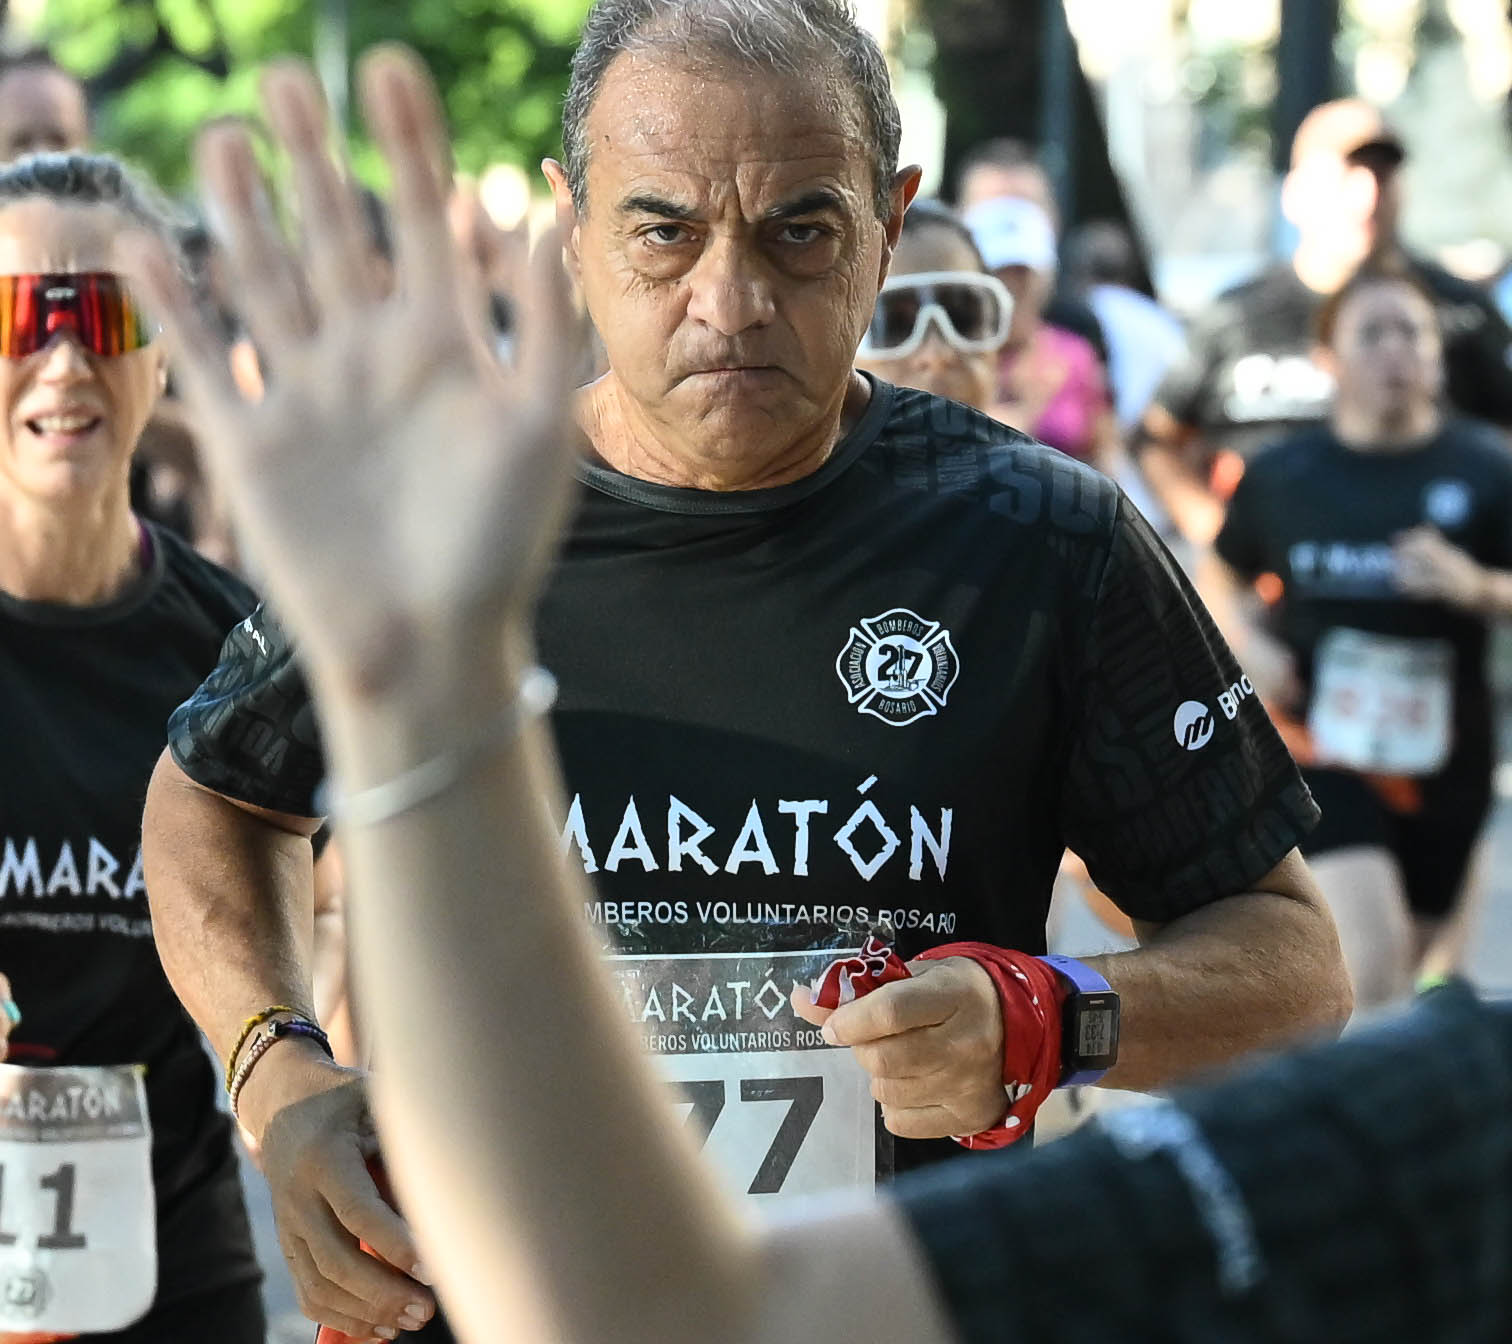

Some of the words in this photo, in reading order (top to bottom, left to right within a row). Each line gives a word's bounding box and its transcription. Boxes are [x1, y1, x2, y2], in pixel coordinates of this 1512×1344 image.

[878, 643, 924, 681] 27
[584, 900, 688, 925] MBEROS
[695, 902, 870, 926] VOLUNTARIOS
[691, 1030, 791, 1051] VOLUNTARIOS
